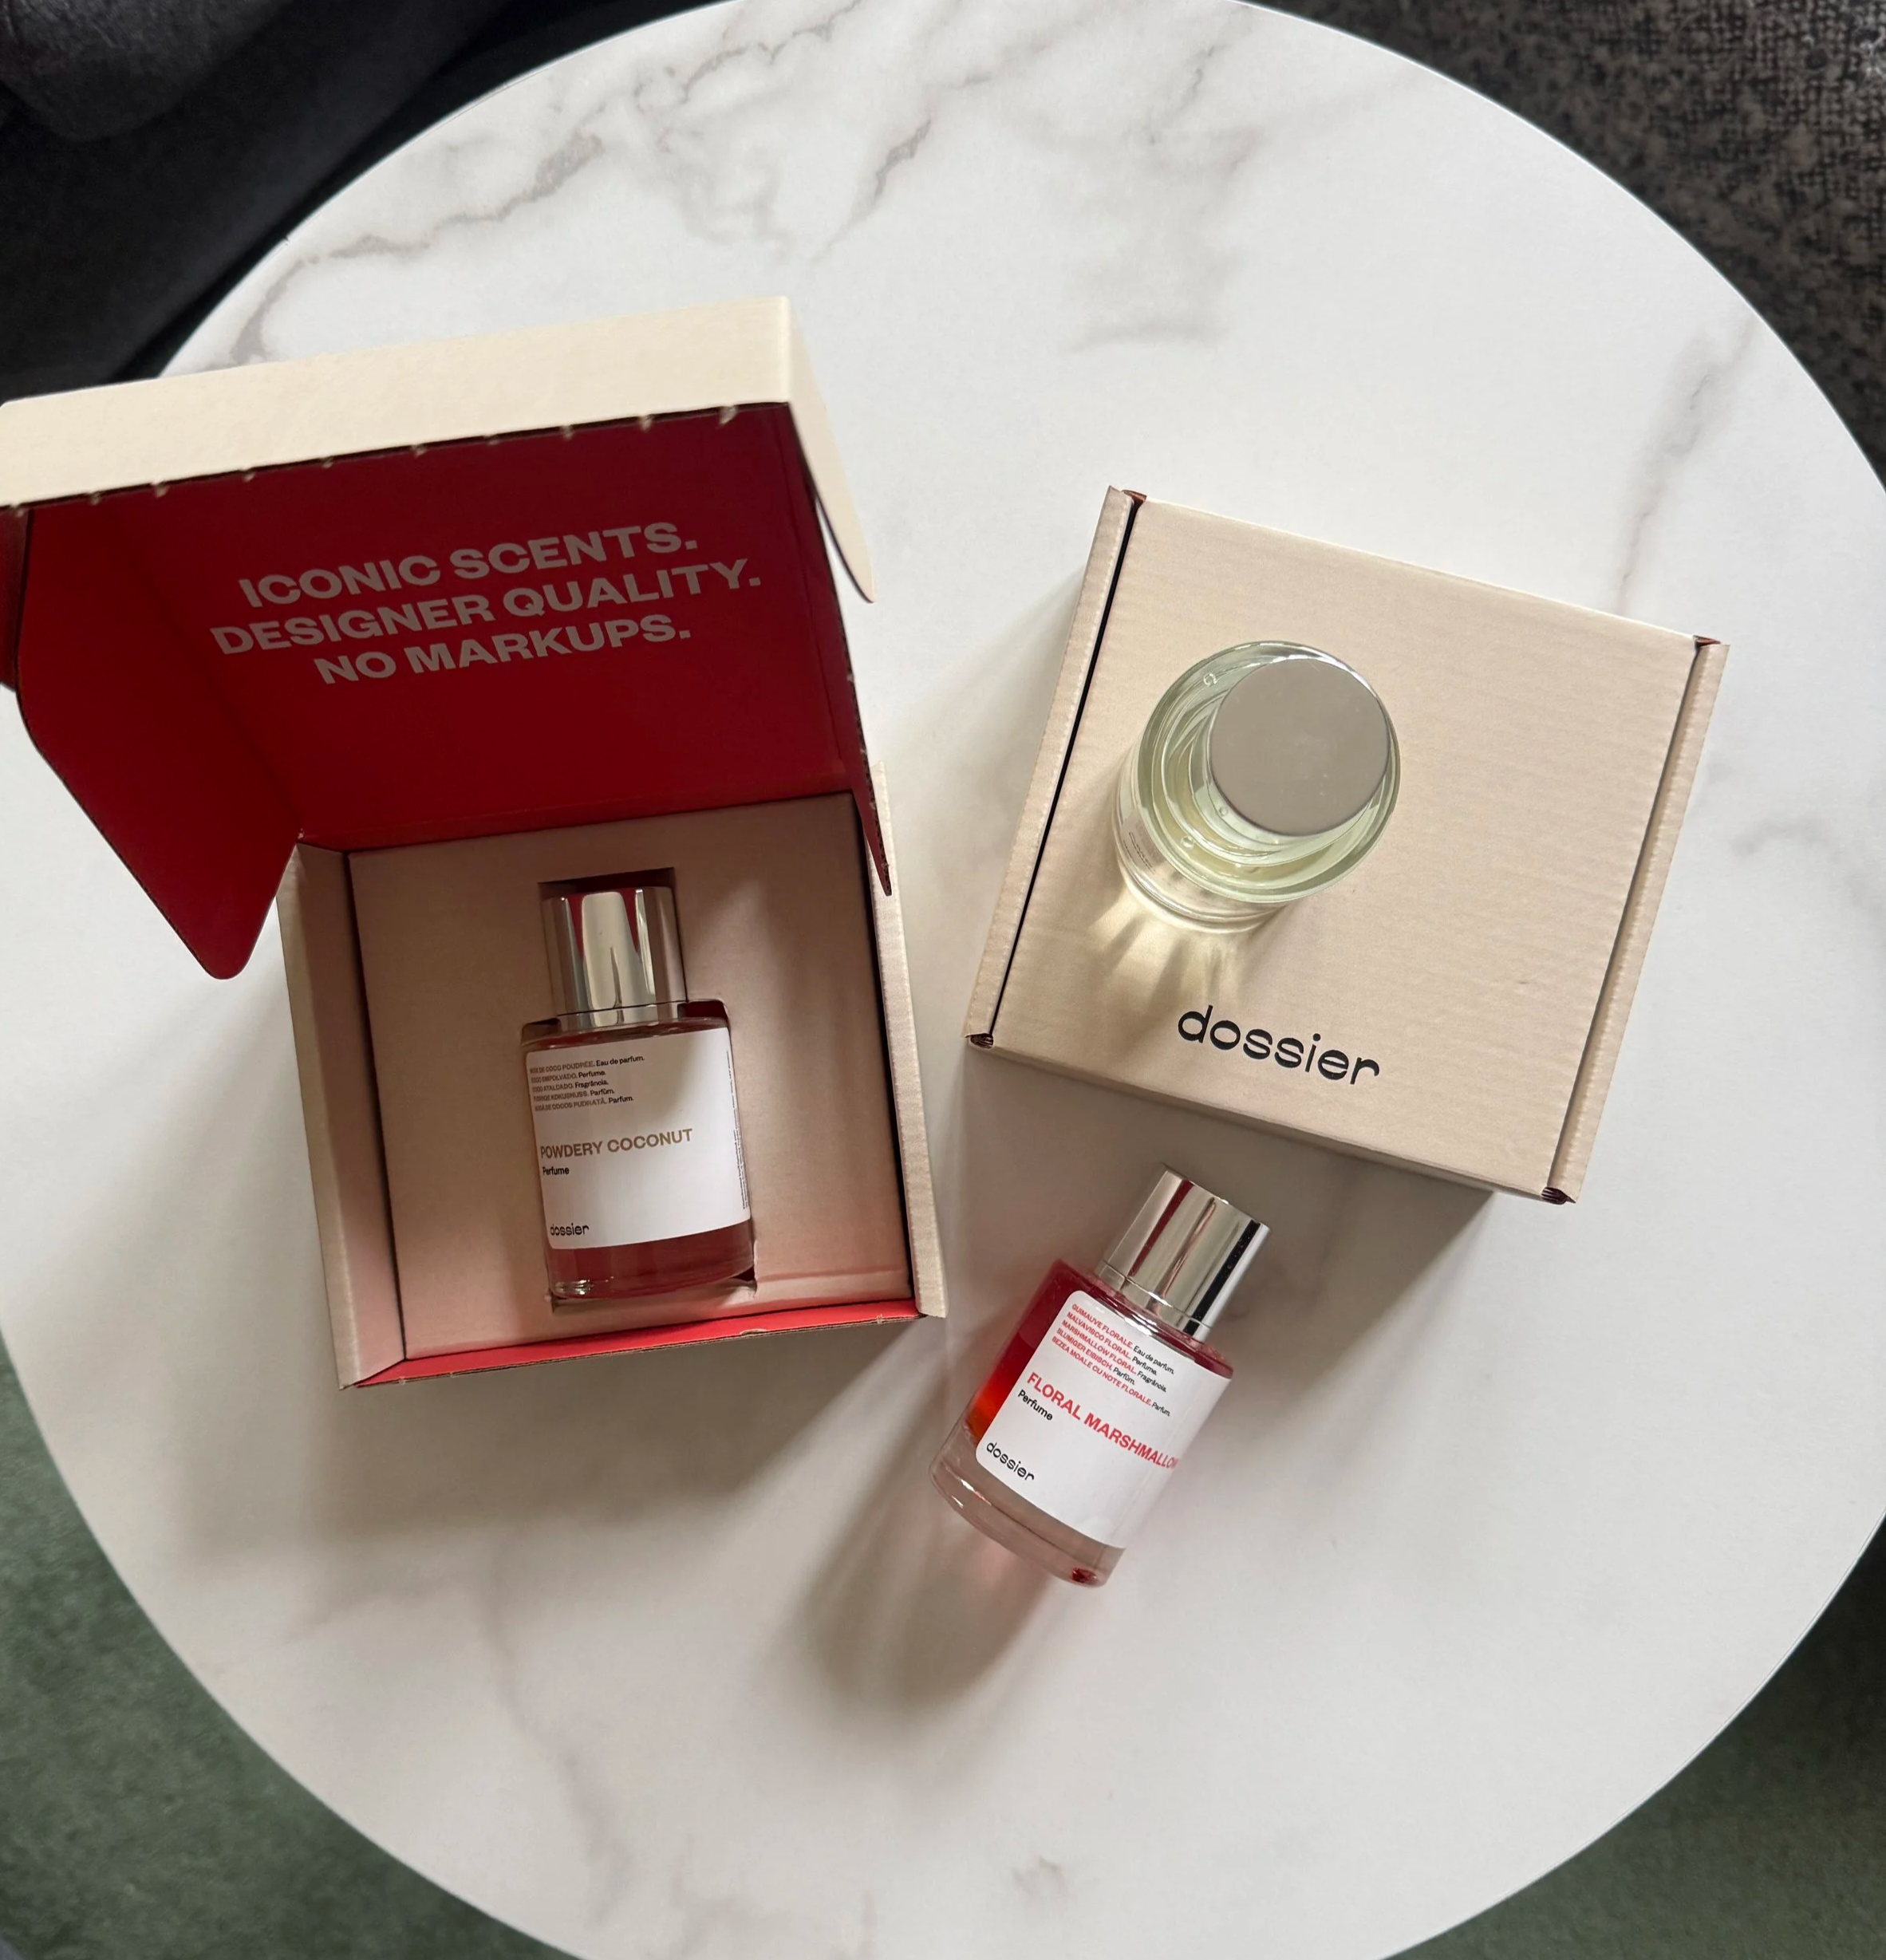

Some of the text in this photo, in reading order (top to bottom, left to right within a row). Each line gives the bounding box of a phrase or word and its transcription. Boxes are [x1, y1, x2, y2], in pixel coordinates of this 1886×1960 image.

[239, 521, 698, 609] ICONIC SCENTS.
[210, 558, 761, 655] DESIGNER QUALITY.
[314, 613, 692, 684] NO MARKUPS.
[619, 1055, 645, 1065] parfum.
[1178, 1004, 1380, 1085] dossier
[574, 1079, 610, 1089] Fragrância.
[540, 1128, 692, 1159] POWDERY COCONUT
[543, 1165, 570, 1176] Perfume
[550, 1223, 590, 1236] dossier
[1056, 1327, 1087, 1352] BLUMIGER
[1086, 1349, 1112, 1370] EIBISCH.
[1062, 1319, 1166, 1393] MARSHMALLOW FLORAL. Fragrância.
[1067, 1312, 1158, 1376] MALVAVISCO FLORAL. Perfume.
[1071, 1303, 1174, 1374] GUIMAUVE FLORALE. Eau de parfum.
[1052, 1335, 1070, 1354] BEZEA
[1070, 1349, 1093, 1369] MOALE
[1092, 1365, 1103, 1375] CU
[1102, 1371, 1123, 1388] NOTE
[1122, 1384, 1151, 1406] FLORALE.
[1018, 1389, 1053, 1421] Perfume
[1027, 1371, 1081, 1421] FLORAL
[986, 1441, 1035, 1481] dossier
